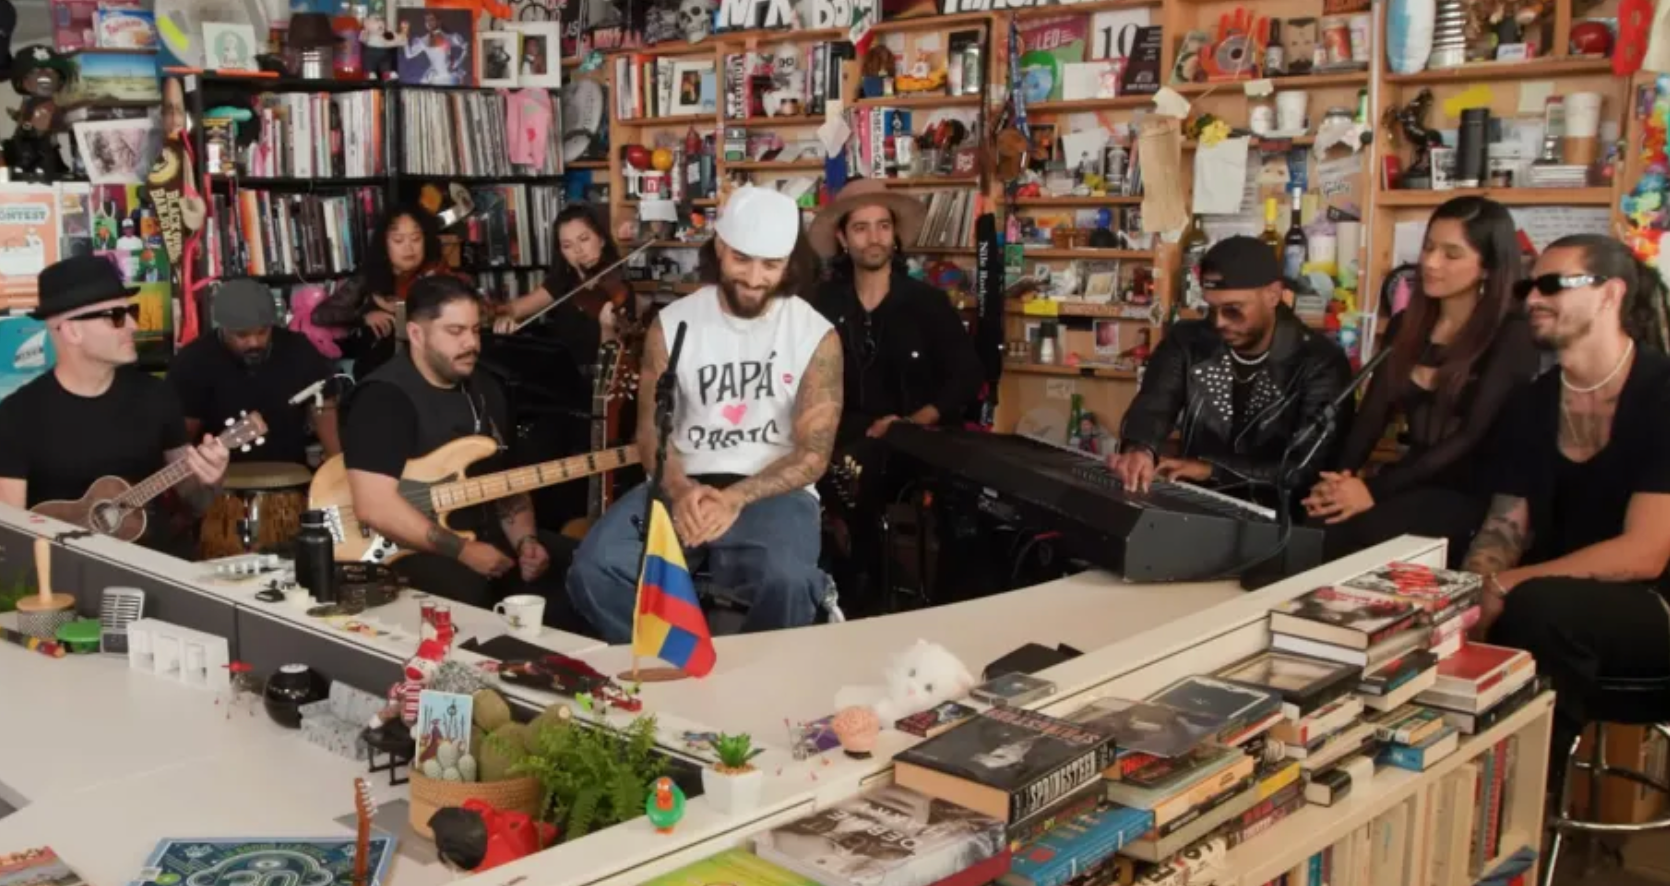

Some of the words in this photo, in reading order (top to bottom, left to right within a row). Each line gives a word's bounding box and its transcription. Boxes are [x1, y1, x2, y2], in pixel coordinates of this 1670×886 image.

[1099, 22, 1139, 59] 10
[979, 241, 988, 268] Nile
[698, 351, 775, 405] PAPÁ
